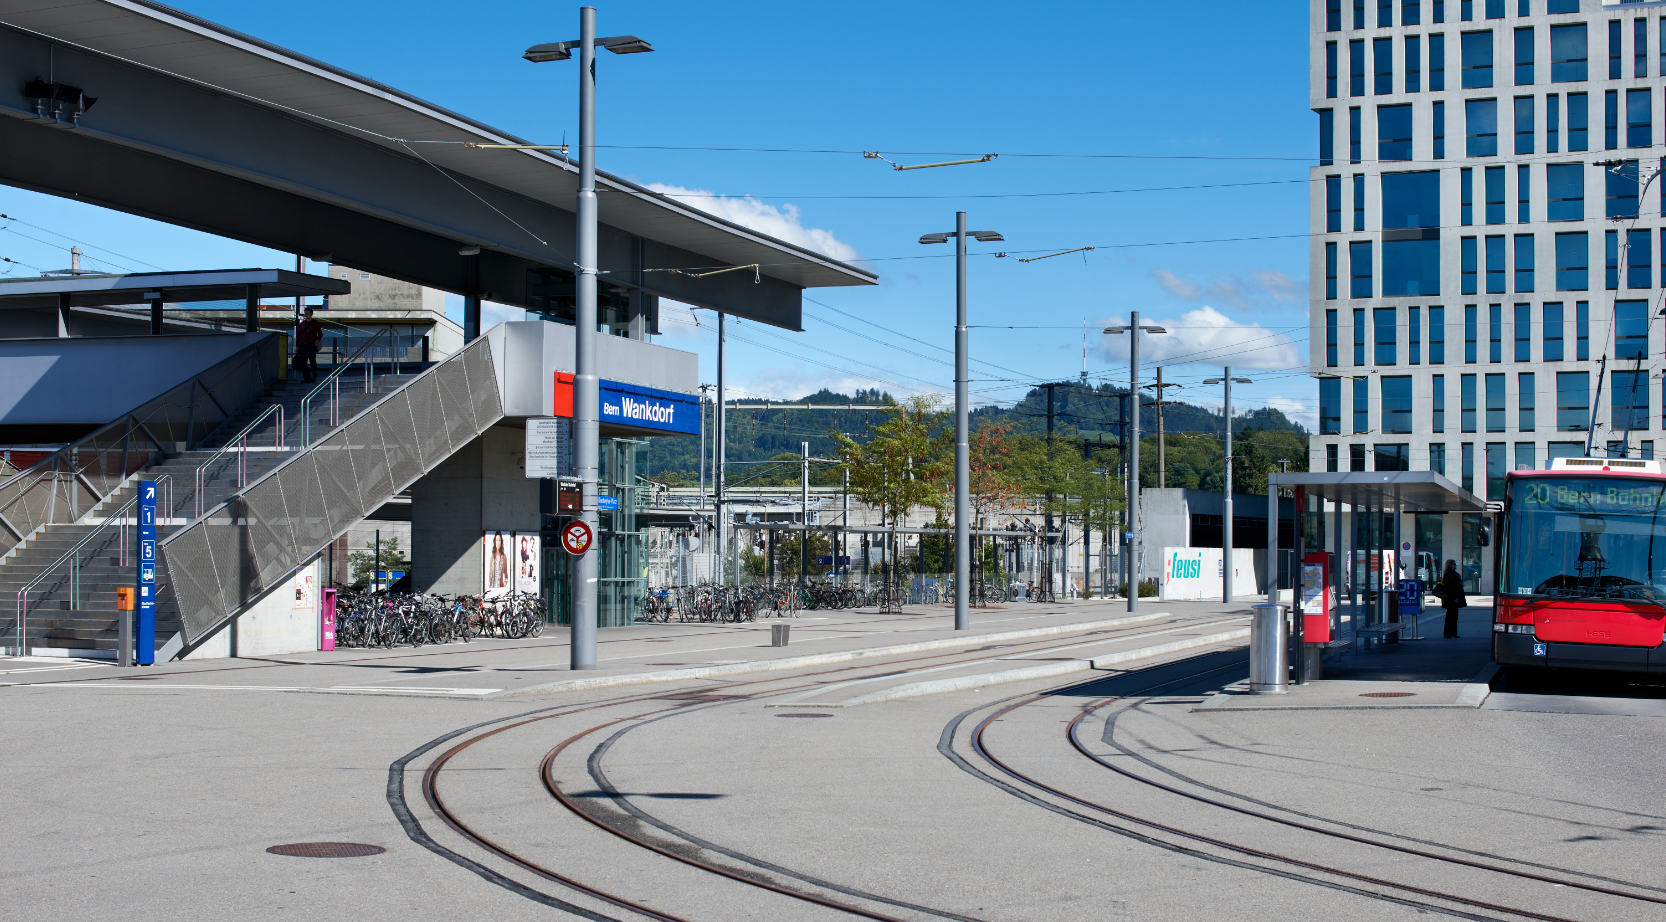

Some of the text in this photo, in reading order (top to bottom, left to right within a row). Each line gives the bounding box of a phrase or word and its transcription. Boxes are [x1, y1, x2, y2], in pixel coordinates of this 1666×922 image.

[604, 397, 674, 423] Bern Wankdorf
[1525, 484, 1666, 506] 20 Bern Bahnh
[146, 511, 151, 523] 1
[145, 545, 152, 558] 5
